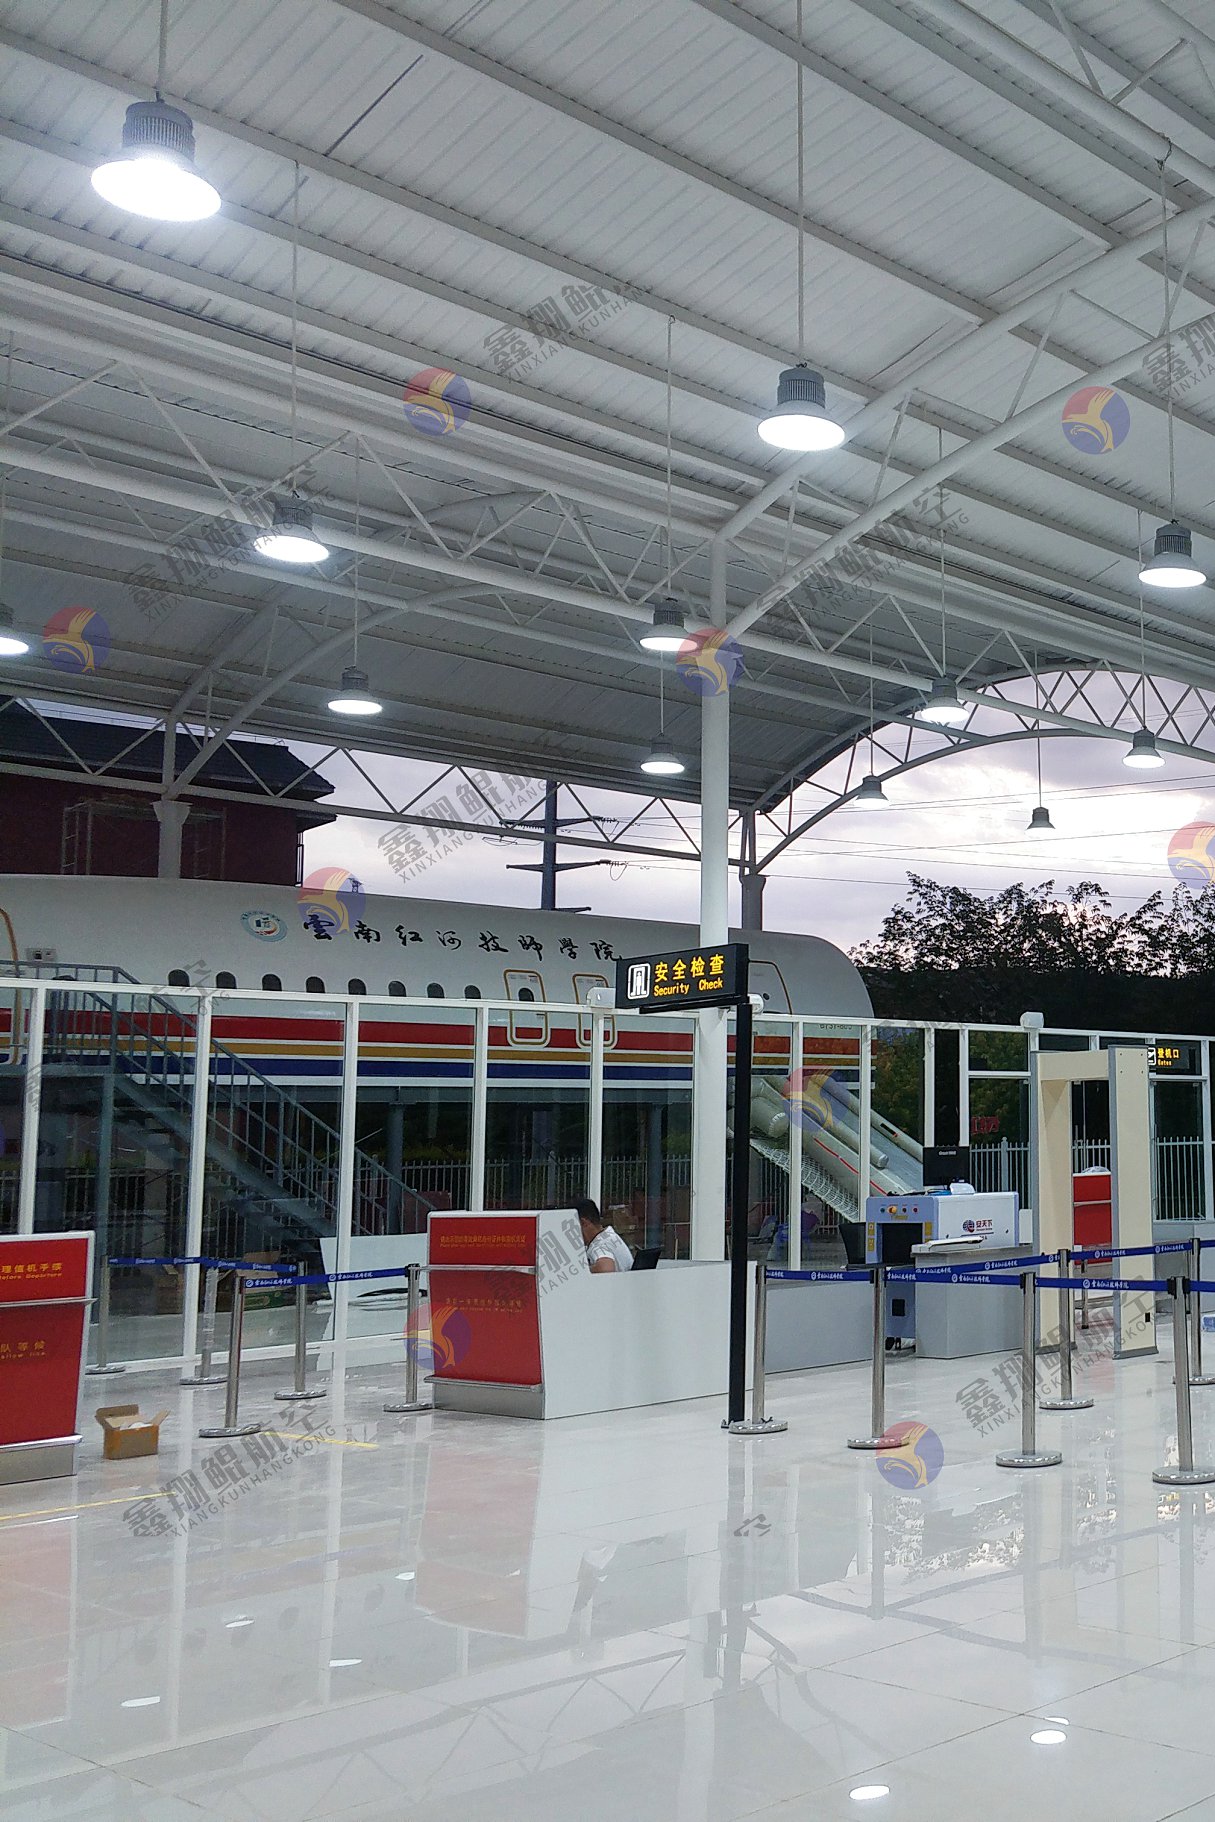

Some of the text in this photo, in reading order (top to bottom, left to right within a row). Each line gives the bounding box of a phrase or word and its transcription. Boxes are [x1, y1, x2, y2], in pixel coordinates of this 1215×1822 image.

[655, 954, 725, 982] 安全检查
[653, 977, 724, 997] Security Check
[1157, 1047, 1180, 1059] 登机口
